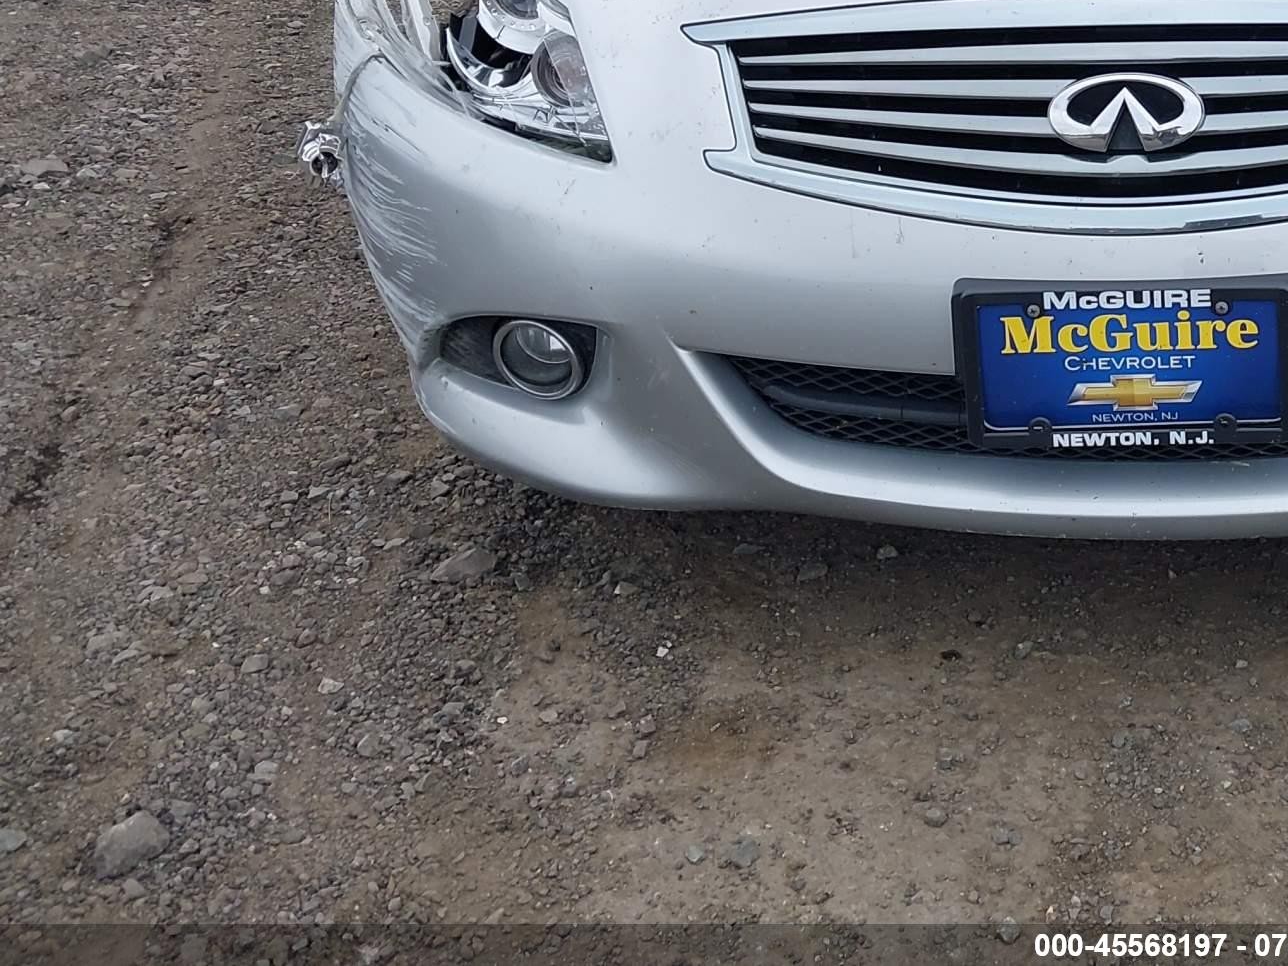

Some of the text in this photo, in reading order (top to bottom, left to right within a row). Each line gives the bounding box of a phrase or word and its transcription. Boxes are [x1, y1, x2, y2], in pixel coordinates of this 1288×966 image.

[1043, 289, 1211, 309] McGUIRE
[1000, 310, 1259, 355] McGuire
[1064, 355, 1196, 371] CHEVROLET
[1092, 411, 1178, 423] NEWTON, NJ
[1052, 431, 1215, 448] NEWTON, N.J.
